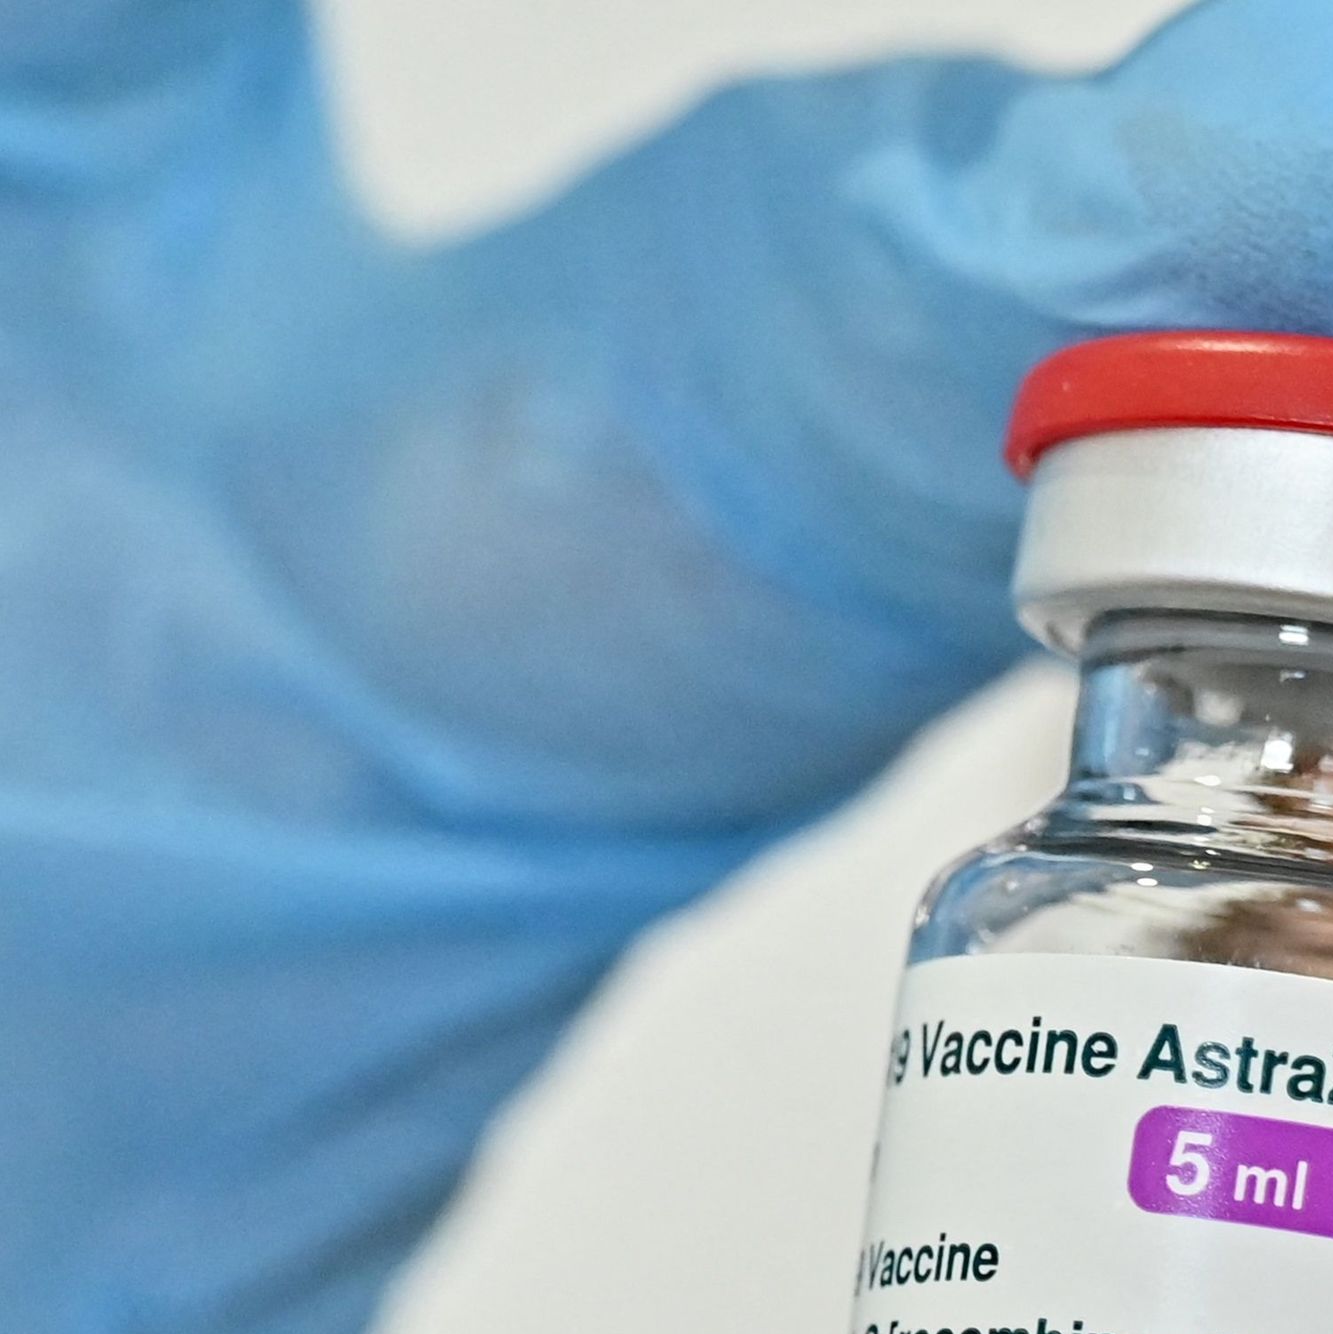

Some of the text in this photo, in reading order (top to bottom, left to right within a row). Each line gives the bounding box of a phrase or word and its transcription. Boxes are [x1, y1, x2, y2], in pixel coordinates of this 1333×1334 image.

[922, 1016, 1119, 1079] Vaccine
[1164, 1130, 1309, 1210] 5 ml
[868, 1232, 999, 1290] Vaccine
